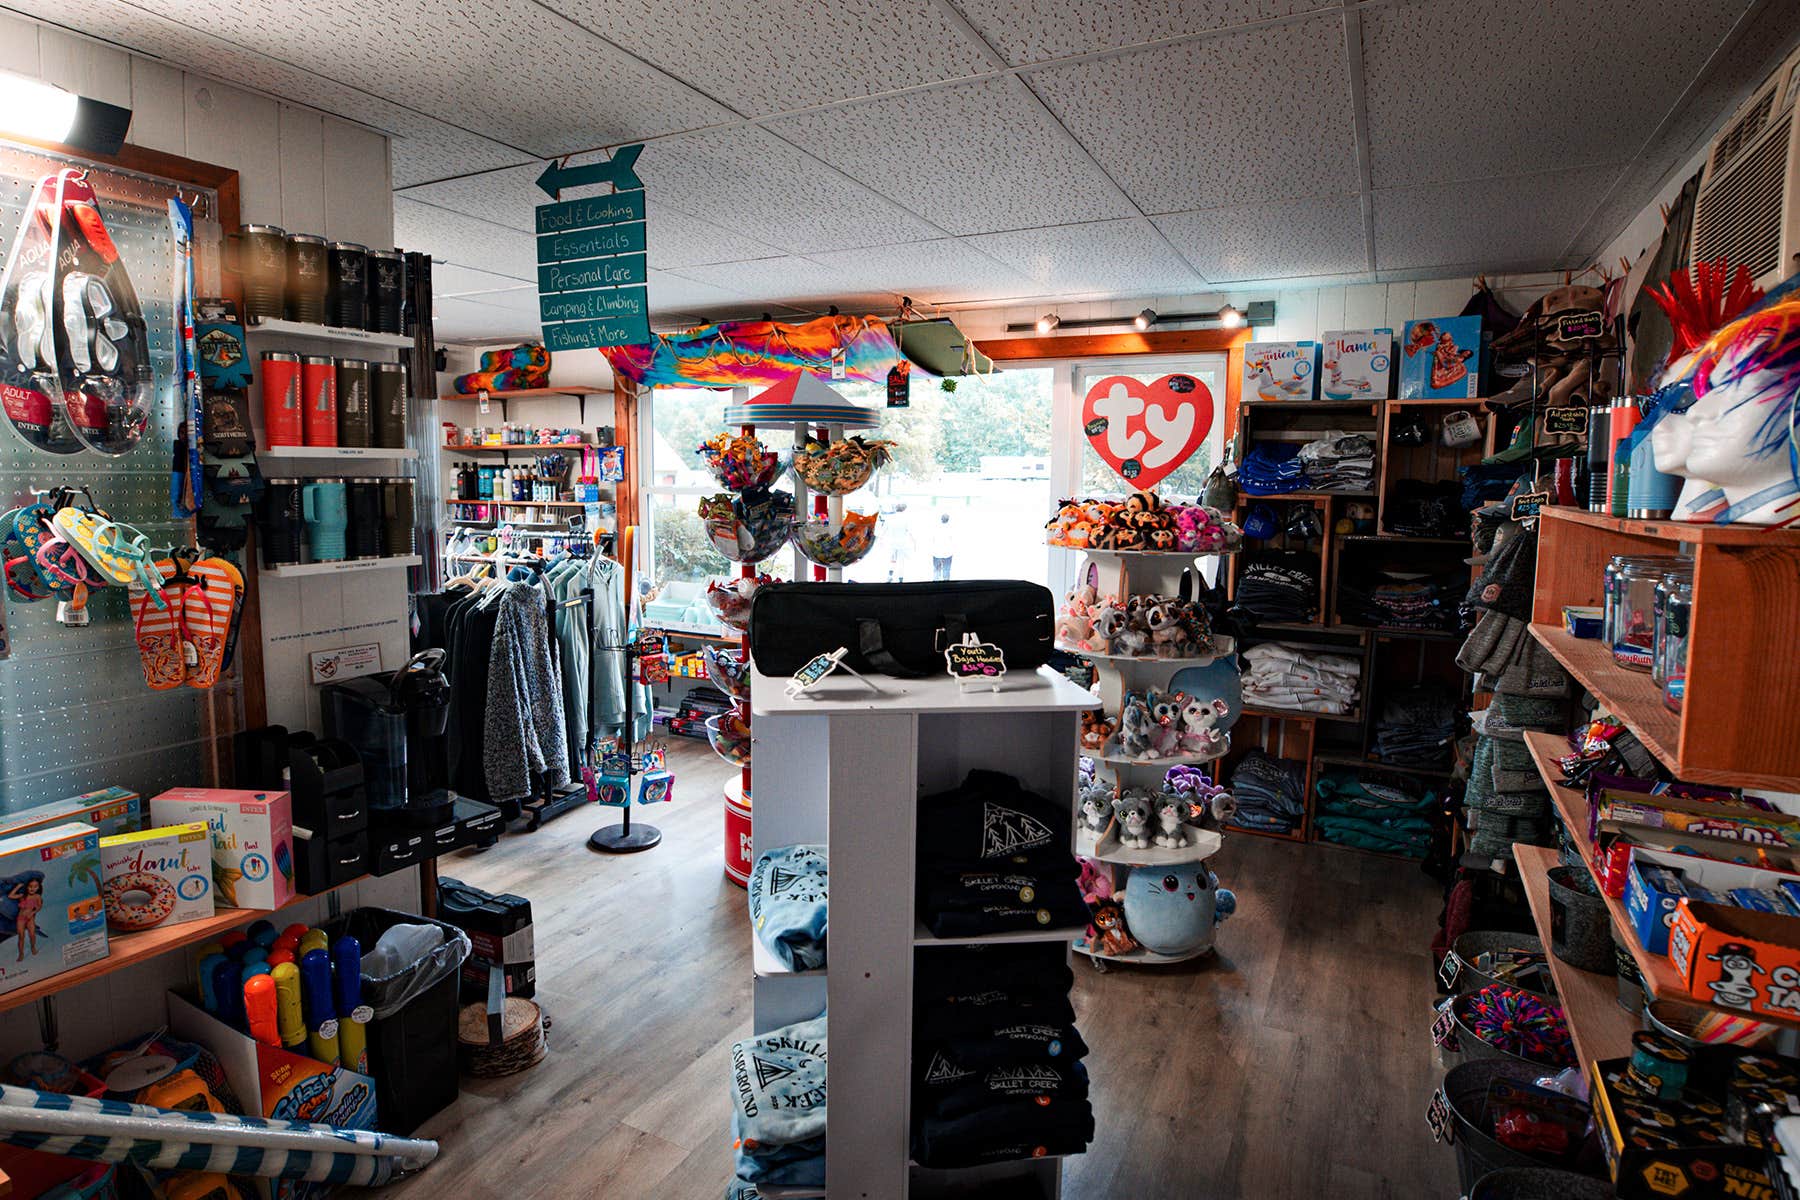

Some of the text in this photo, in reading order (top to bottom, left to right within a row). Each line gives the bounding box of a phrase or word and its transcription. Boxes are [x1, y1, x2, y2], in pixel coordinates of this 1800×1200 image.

[539, 207, 572, 230] Food
[586, 203, 634, 222] Cooking
[58, 239, 82, 271] AQUA
[553, 232, 630, 257] Essentials
[550, 265, 632, 290] Personal Care
[543, 300, 587, 319] Camping
[596, 294, 640, 314] Climbing
[552, 326, 590, 347] Fishing
[598, 324, 629, 342] More
[3, 387, 32, 400] ADULT
[17, 421, 41, 432] INTEX
[1093, 382, 1196, 469] ty
[952, 654, 975, 664] Baja
[960, 647, 986, 656] Youth
[93, 803, 136, 822] INTEX
[44, 837, 95, 859] INTEX
[129, 848, 190, 873] donut
[732, 1043, 759, 1118] CAMPGROUND
[989, 1079, 1058, 1090] SKILLET CREEK
[271, 1071, 336, 1119] Splash
